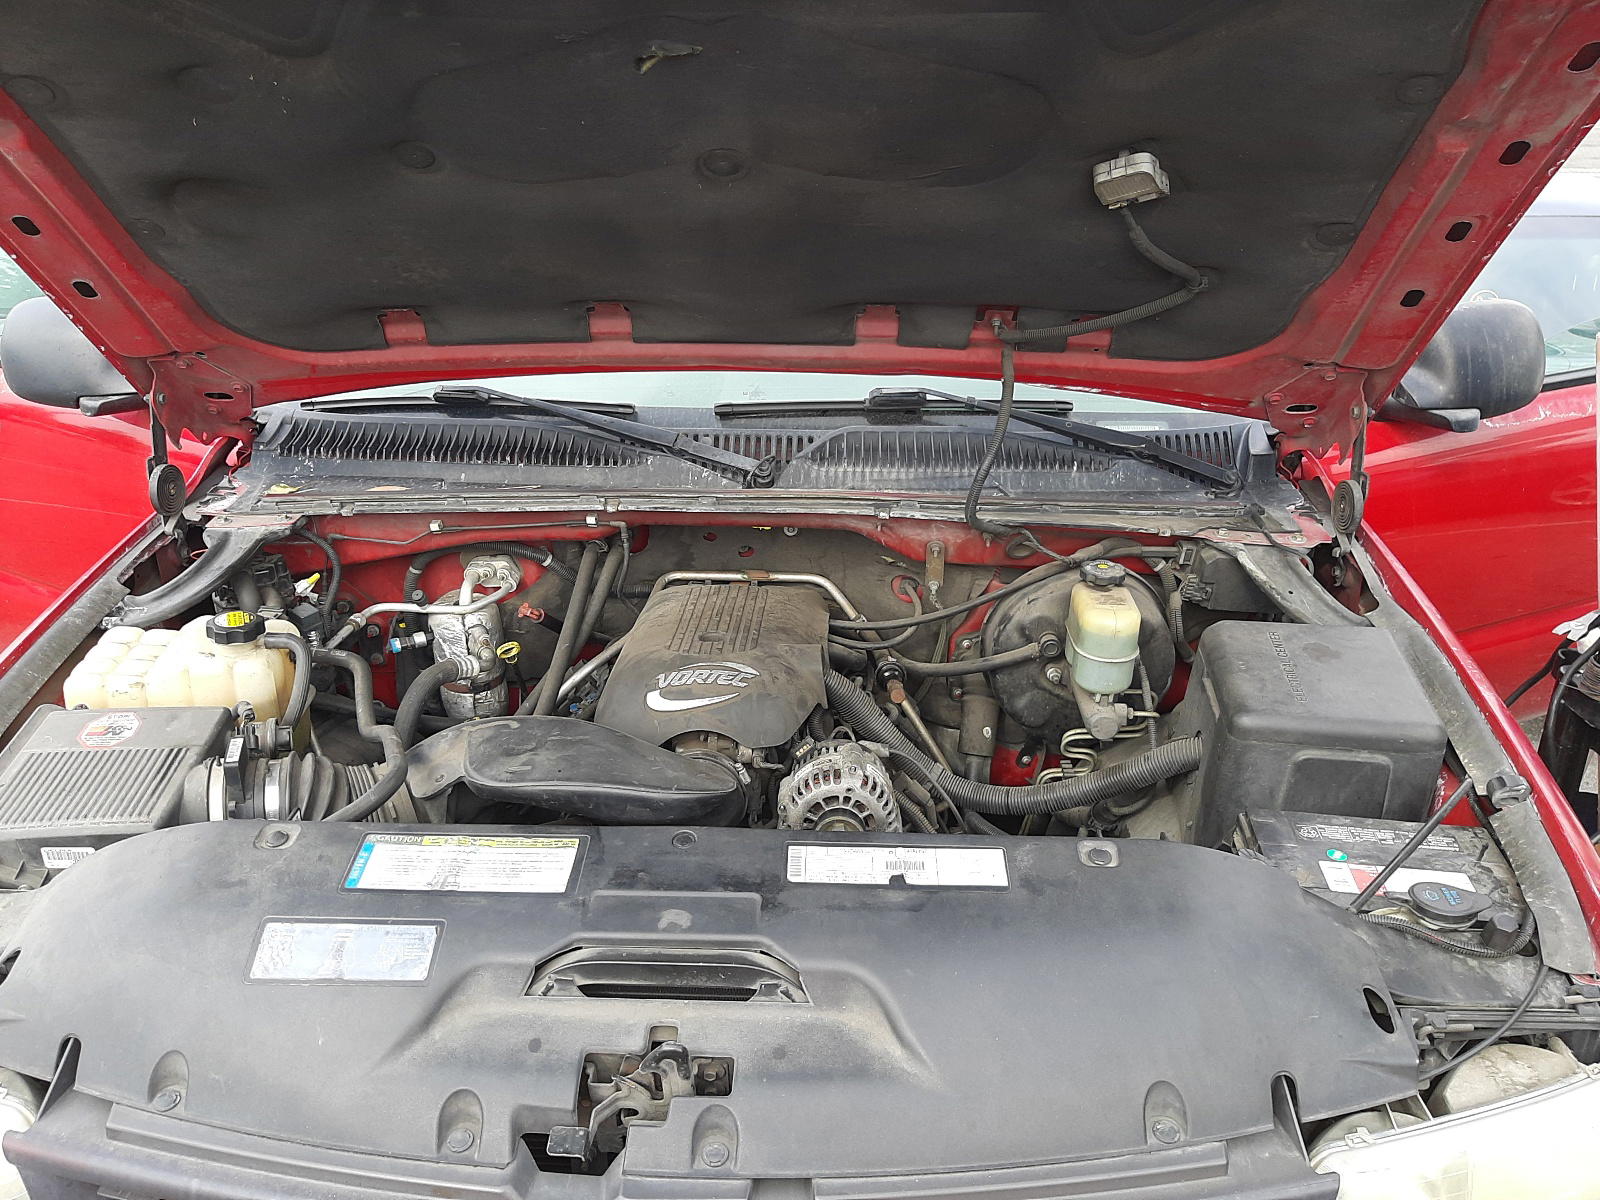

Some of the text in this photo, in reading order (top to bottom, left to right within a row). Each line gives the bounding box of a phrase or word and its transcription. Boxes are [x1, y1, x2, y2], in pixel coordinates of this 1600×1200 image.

[1267, 631, 1308, 703] ELECTRICAL CENTER
[656, 669, 755, 689] VORTEC
[377, 835, 422, 844] CAUTION
